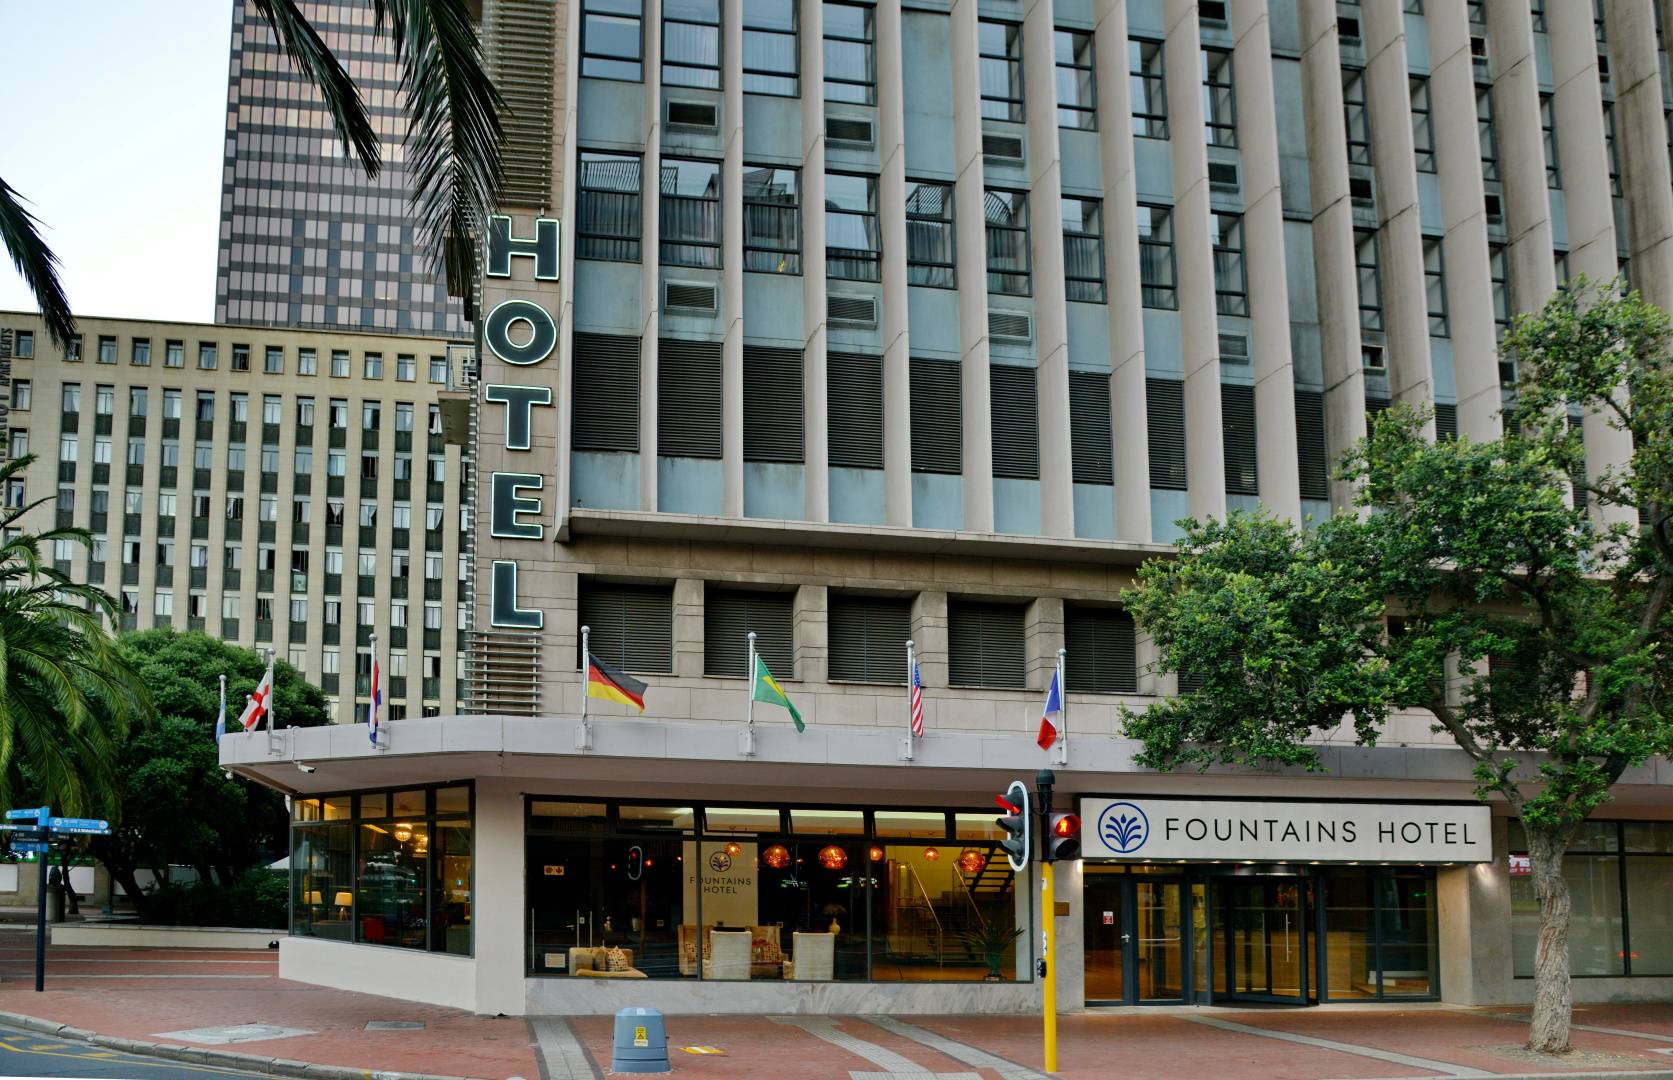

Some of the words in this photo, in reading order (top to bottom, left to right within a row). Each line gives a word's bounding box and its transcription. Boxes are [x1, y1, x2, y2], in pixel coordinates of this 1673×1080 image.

[0, 327, 13, 386] APARTMENTS
[484, 214, 560, 629] HOTEL
[1166, 819, 1356, 842] FOUNTAINS
[1379, 822, 1475, 844] HOTEL
[704, 886, 737, 894] HOTEL
